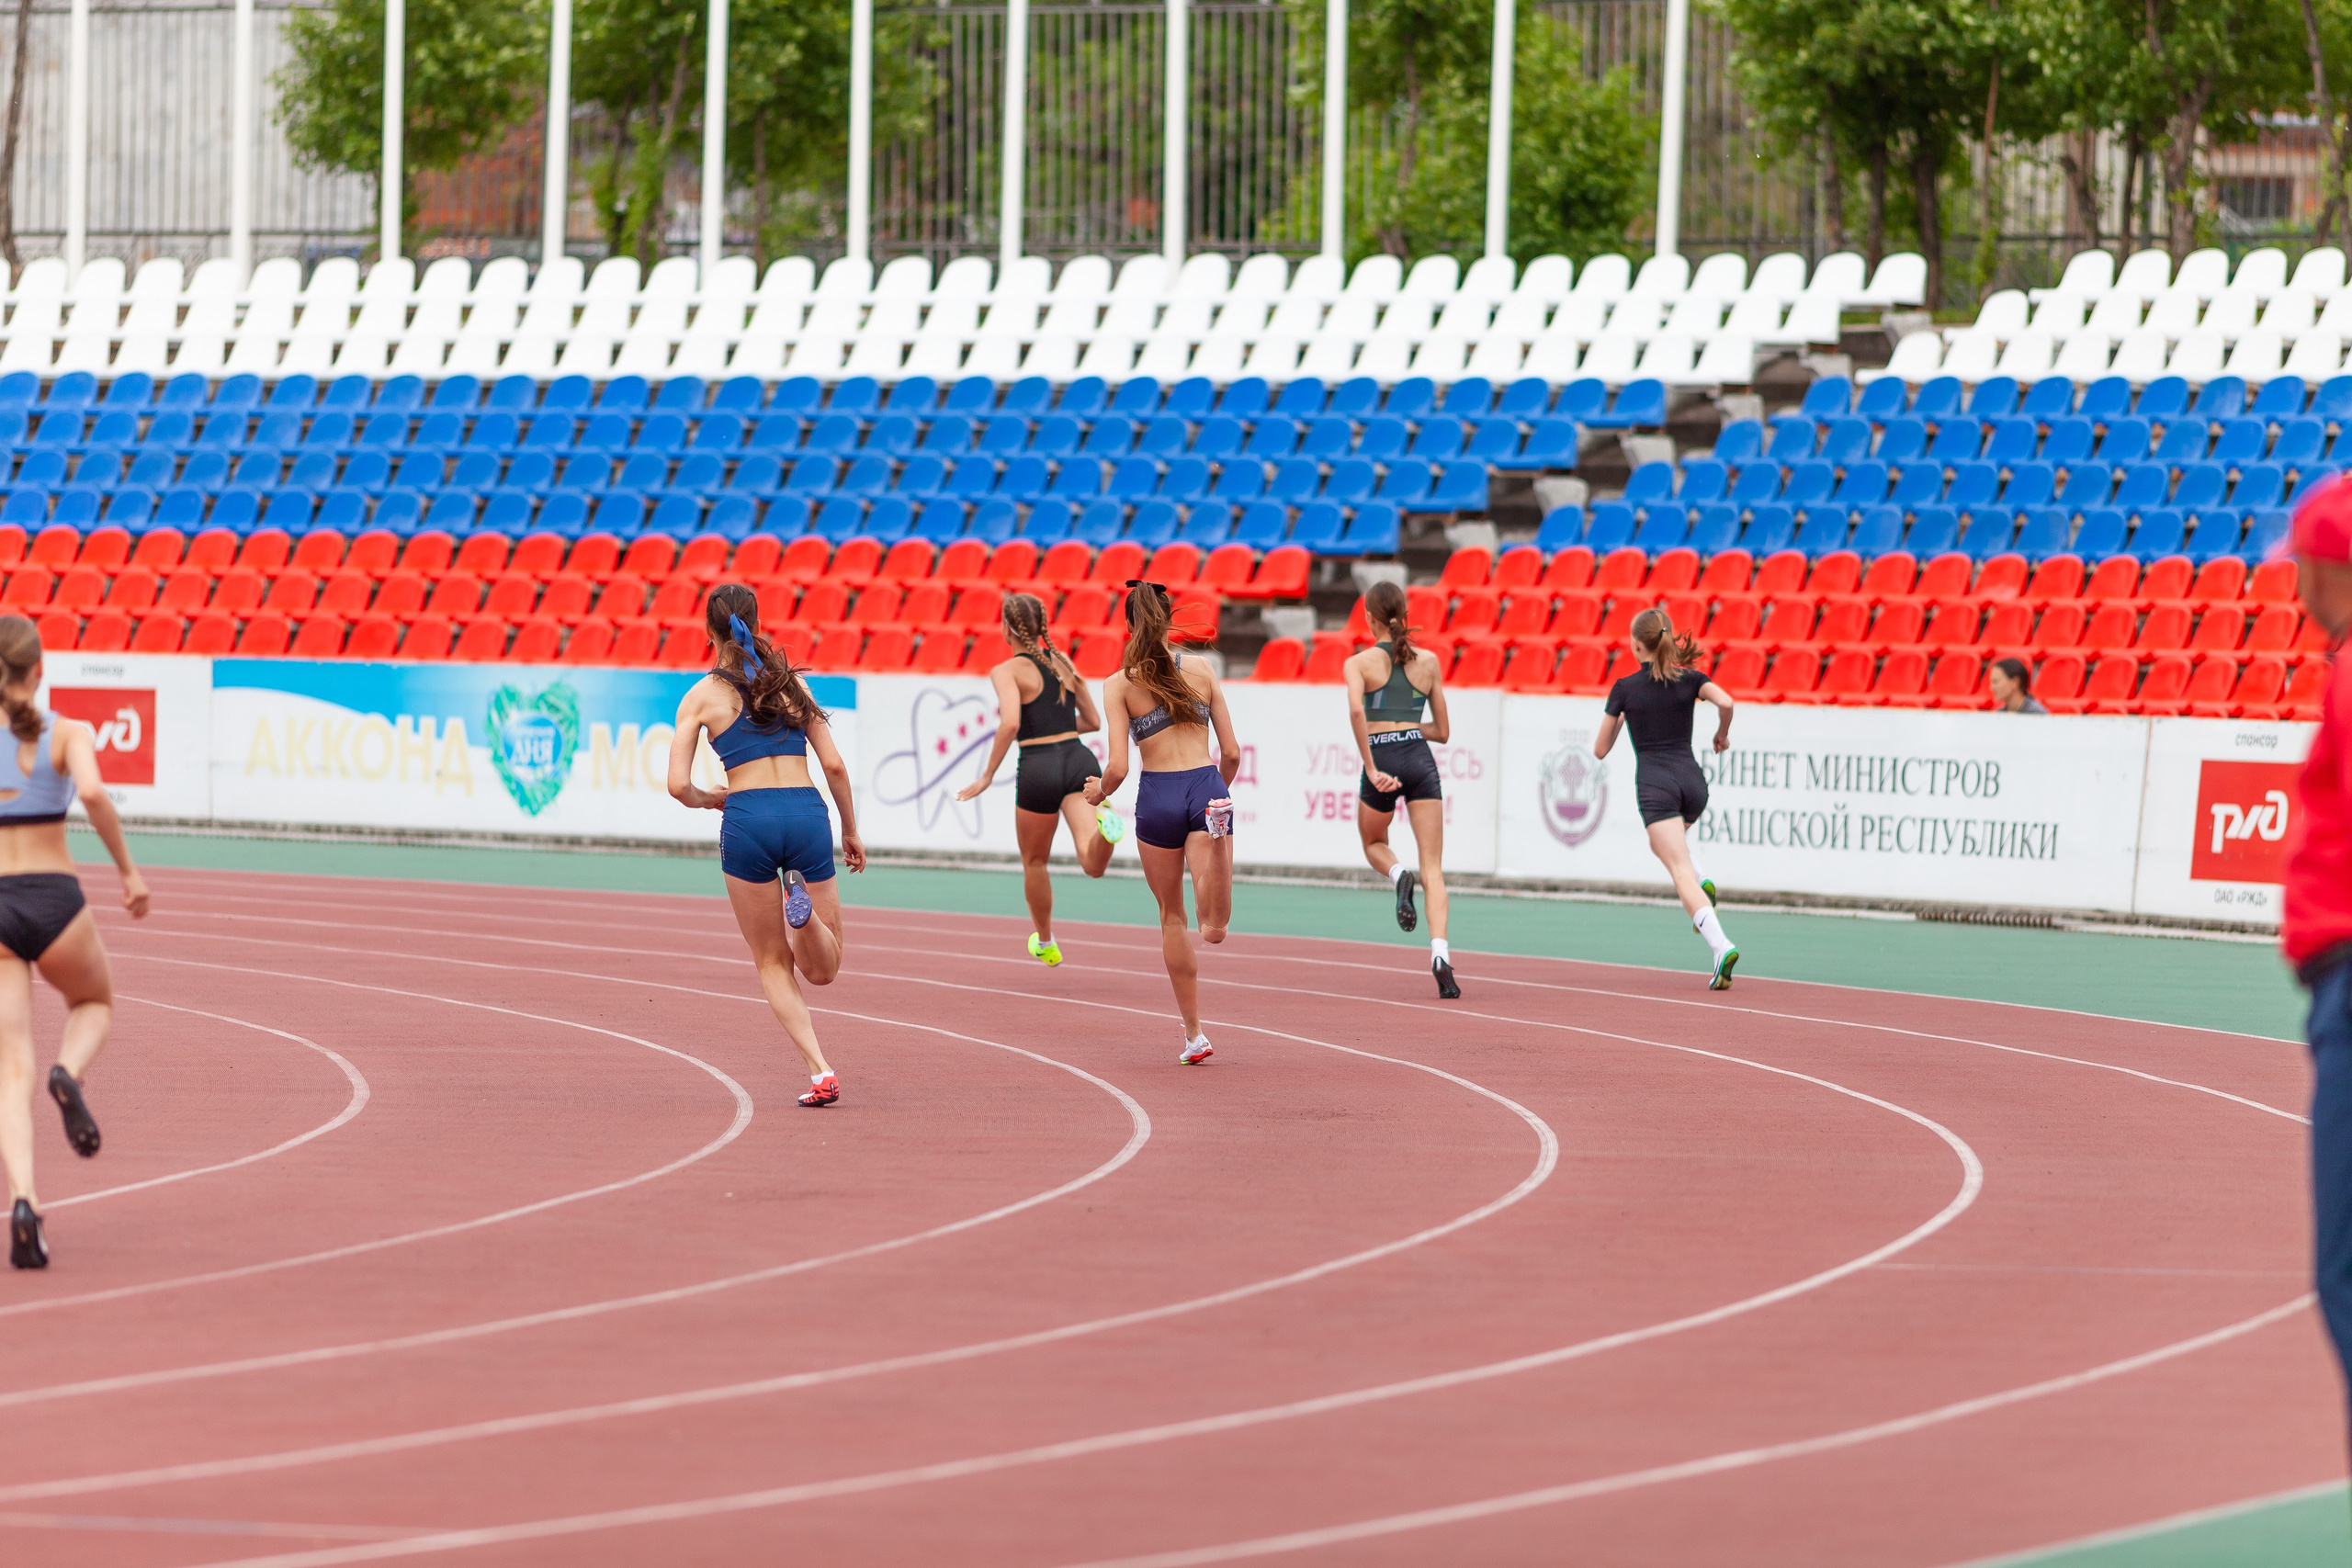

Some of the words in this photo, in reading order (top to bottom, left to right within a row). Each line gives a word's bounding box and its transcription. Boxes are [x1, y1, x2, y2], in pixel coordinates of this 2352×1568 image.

[243, 714, 474, 797] АККОНД
[1306, 742, 1485, 781] УЛЫЕСЬ
[1701, 750, 1796, 790] БИНЕТ
[1805, 752, 2001, 798] МИНИСТРОВ
[1698, 802, 1849, 851] ВАШСКОЙ
[1859, 813, 2060, 860] РЕСПУБЛИКИ
